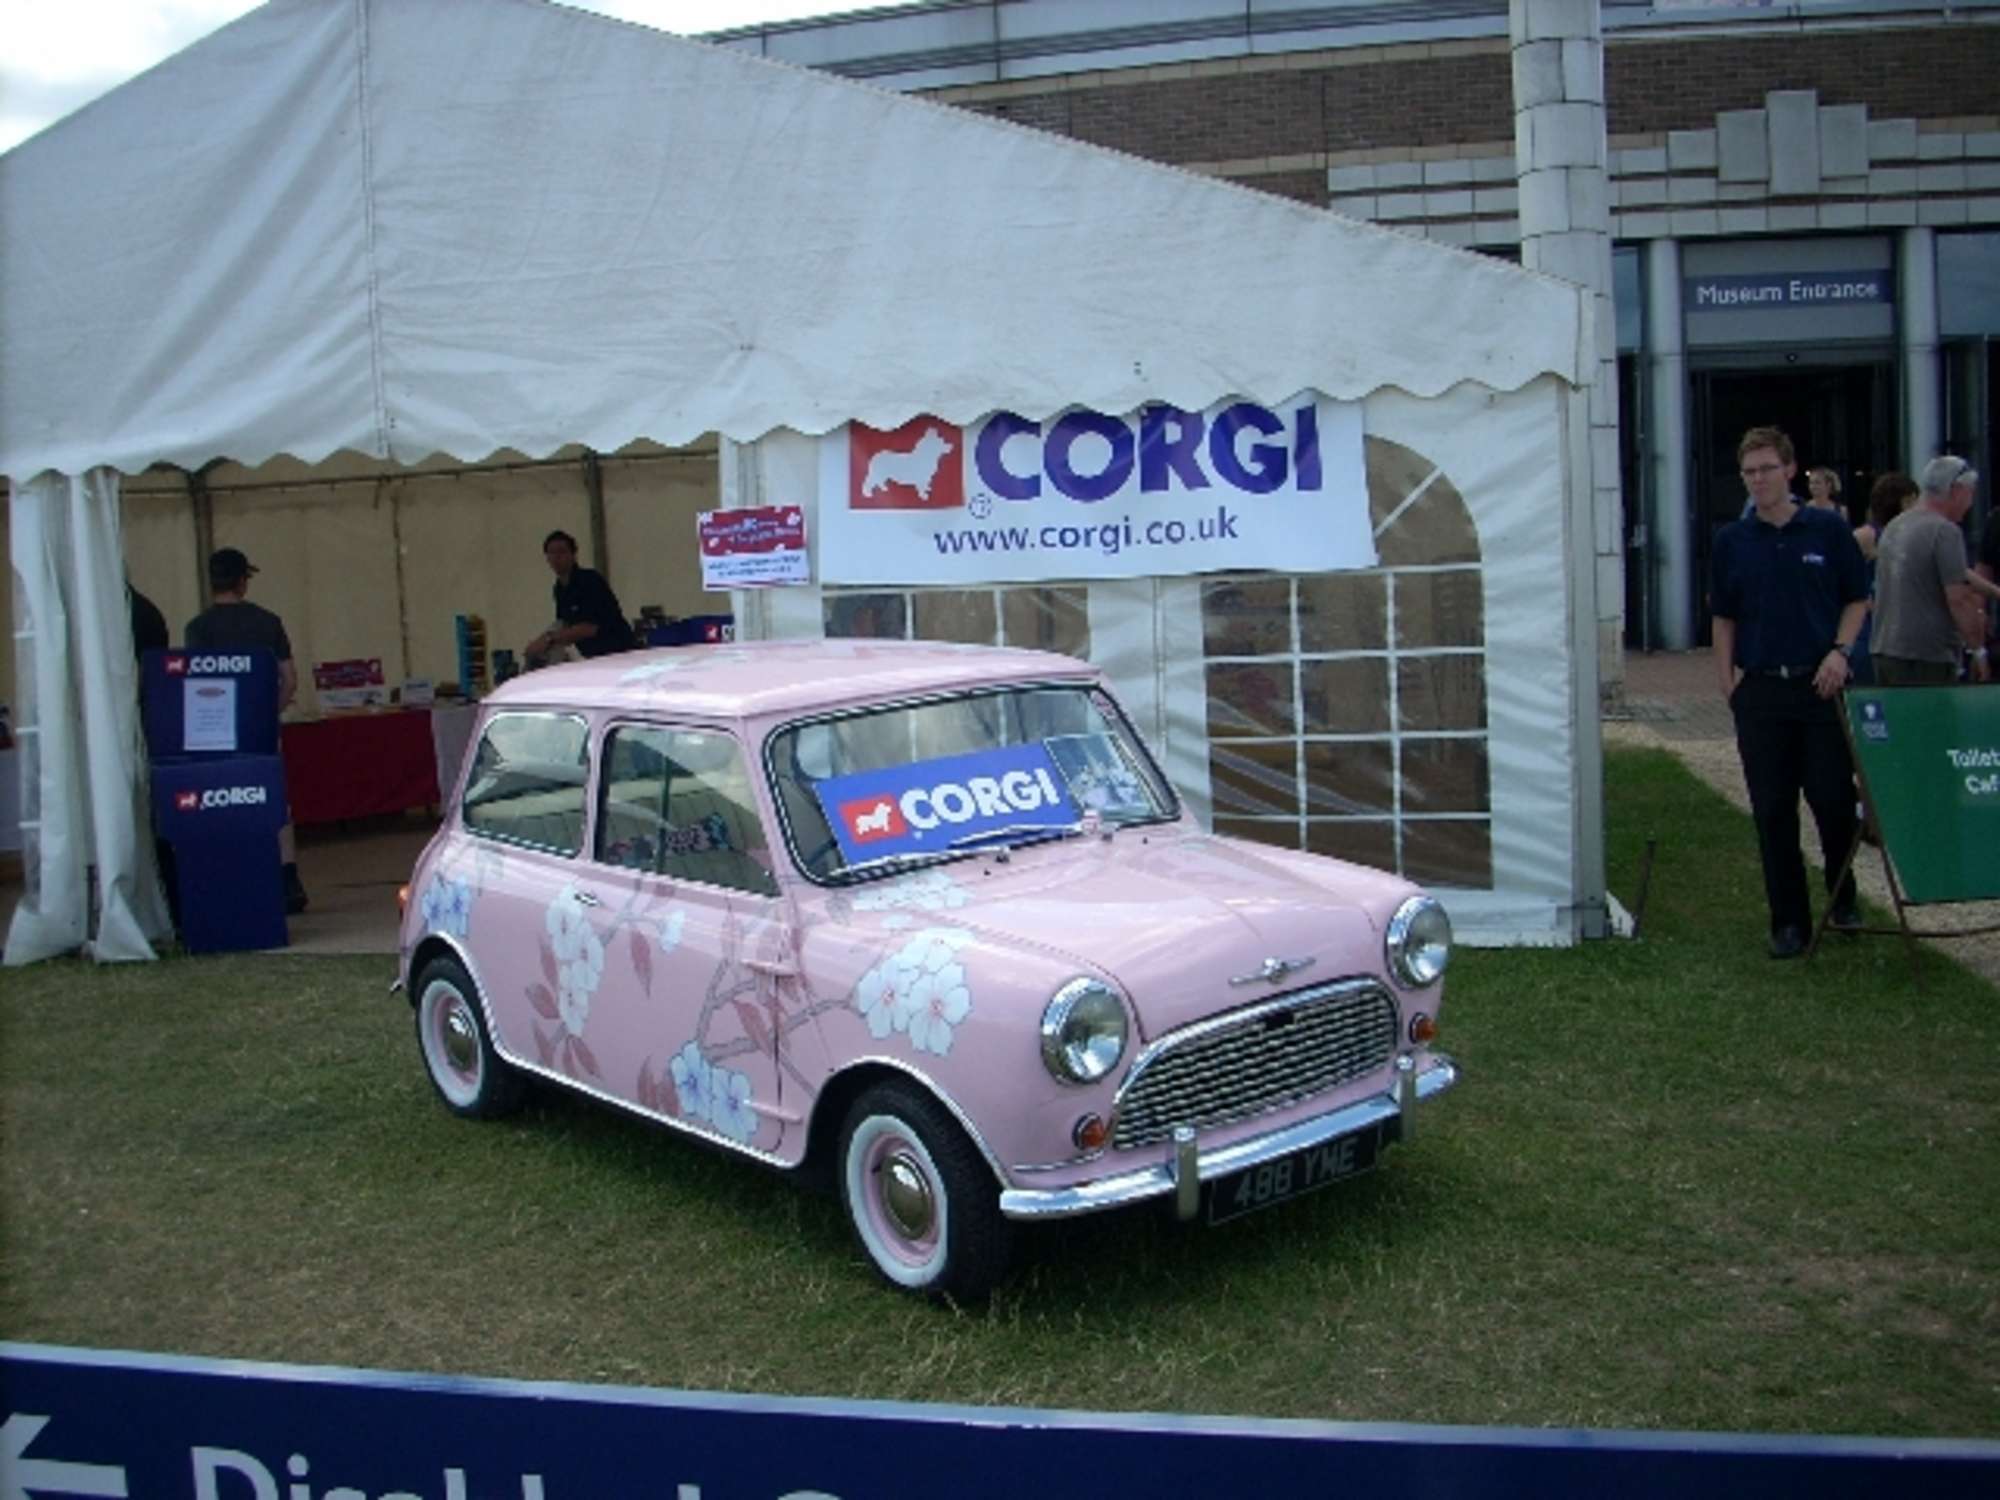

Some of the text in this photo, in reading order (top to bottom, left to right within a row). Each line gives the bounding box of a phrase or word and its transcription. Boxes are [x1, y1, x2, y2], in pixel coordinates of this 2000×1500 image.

[1697, 281, 1878, 304] Museum Entrance
[975, 402, 1322, 502] CORGI
[934, 506, 1239, 555] www.corgi.co.uk
[191, 655, 251, 673] CORGI
[203, 786, 266, 807] CORGI
[900, 768, 1060, 829] CORGI
